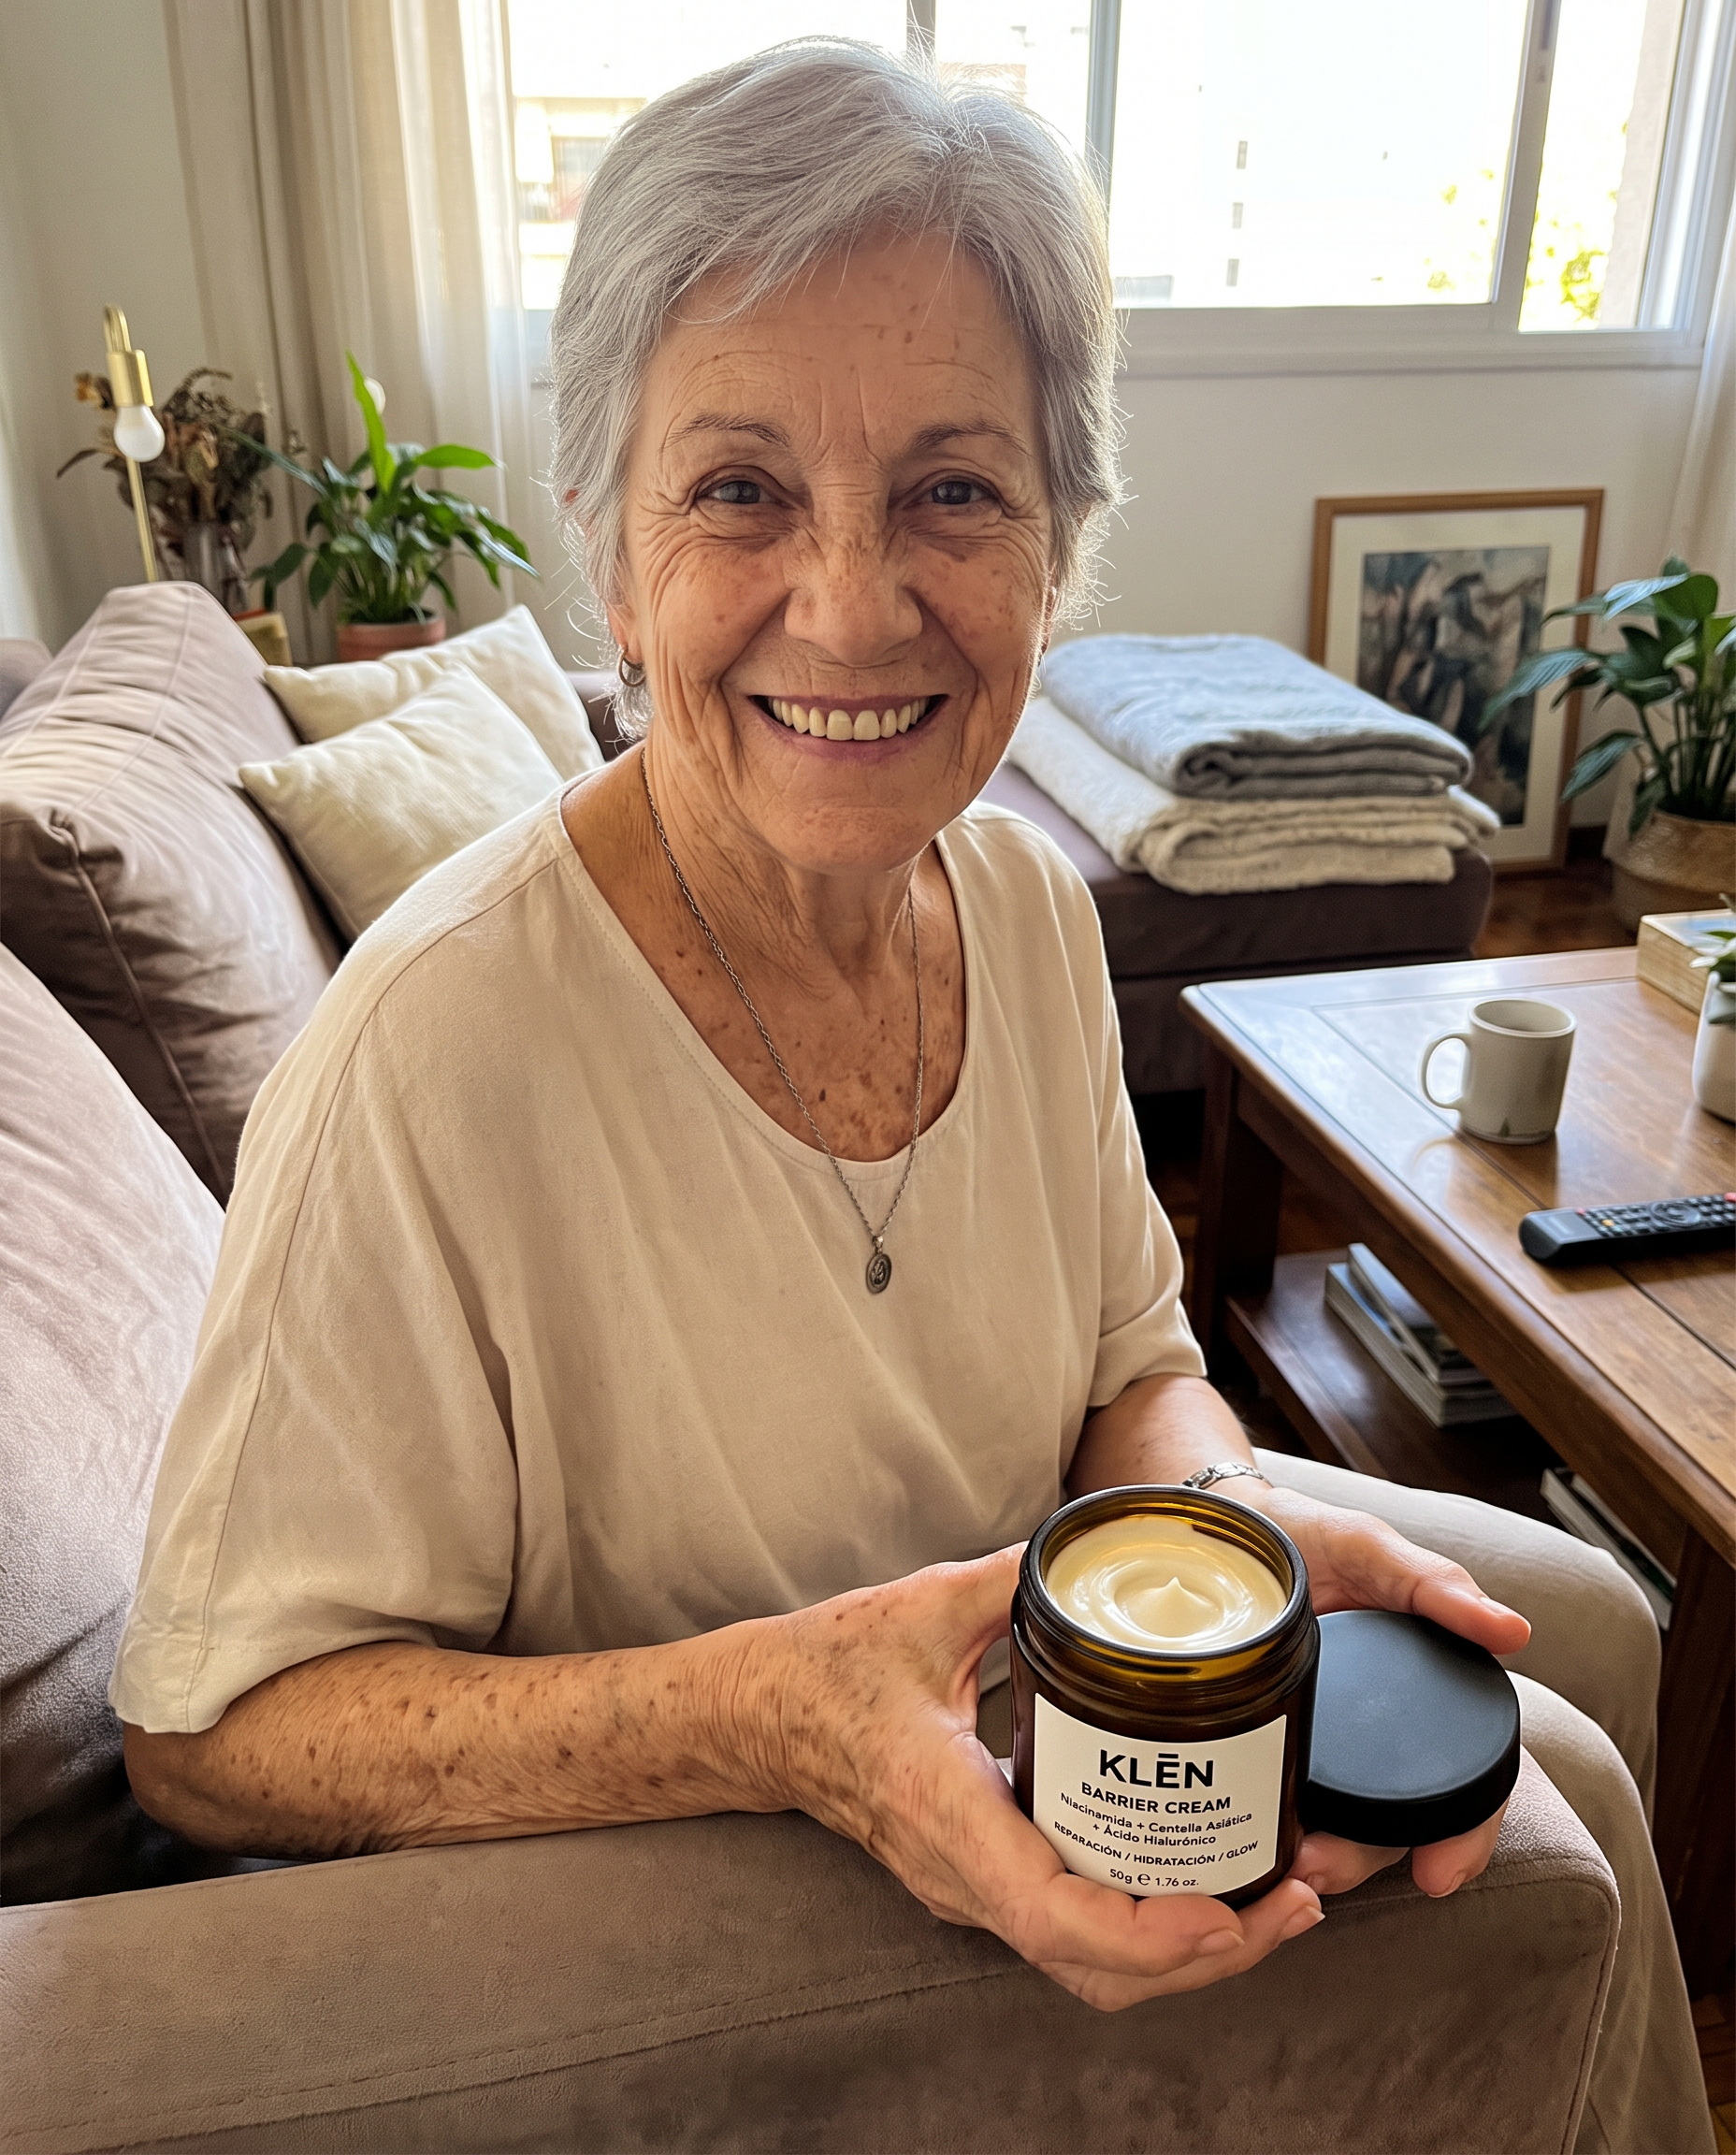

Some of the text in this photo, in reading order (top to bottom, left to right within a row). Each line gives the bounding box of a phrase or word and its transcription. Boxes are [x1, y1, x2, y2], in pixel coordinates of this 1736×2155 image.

[1100, 1749, 1213, 1788] KLĒN
[1081, 1782, 1231, 1815] BARRIER CREAM
[1104, 1824, 1139, 1843] Ácido
[1145, 1834, 1216, 1846] Hialurónico
[1149, 1822, 1202, 1833] Centella
[1206, 1813, 1251, 1831] Asiática
[1054, 1821, 1121, 1859] REPARACIÓN
[1134, 1854, 1215, 1866] HIDRATACIÓN
[1226, 1841, 1258, 1859] GLOW
[1110, 1869, 1133, 1884] 50g
[1156, 1877, 1179, 1887] 1.76
[1182, 1878, 1199, 1887] oz.
